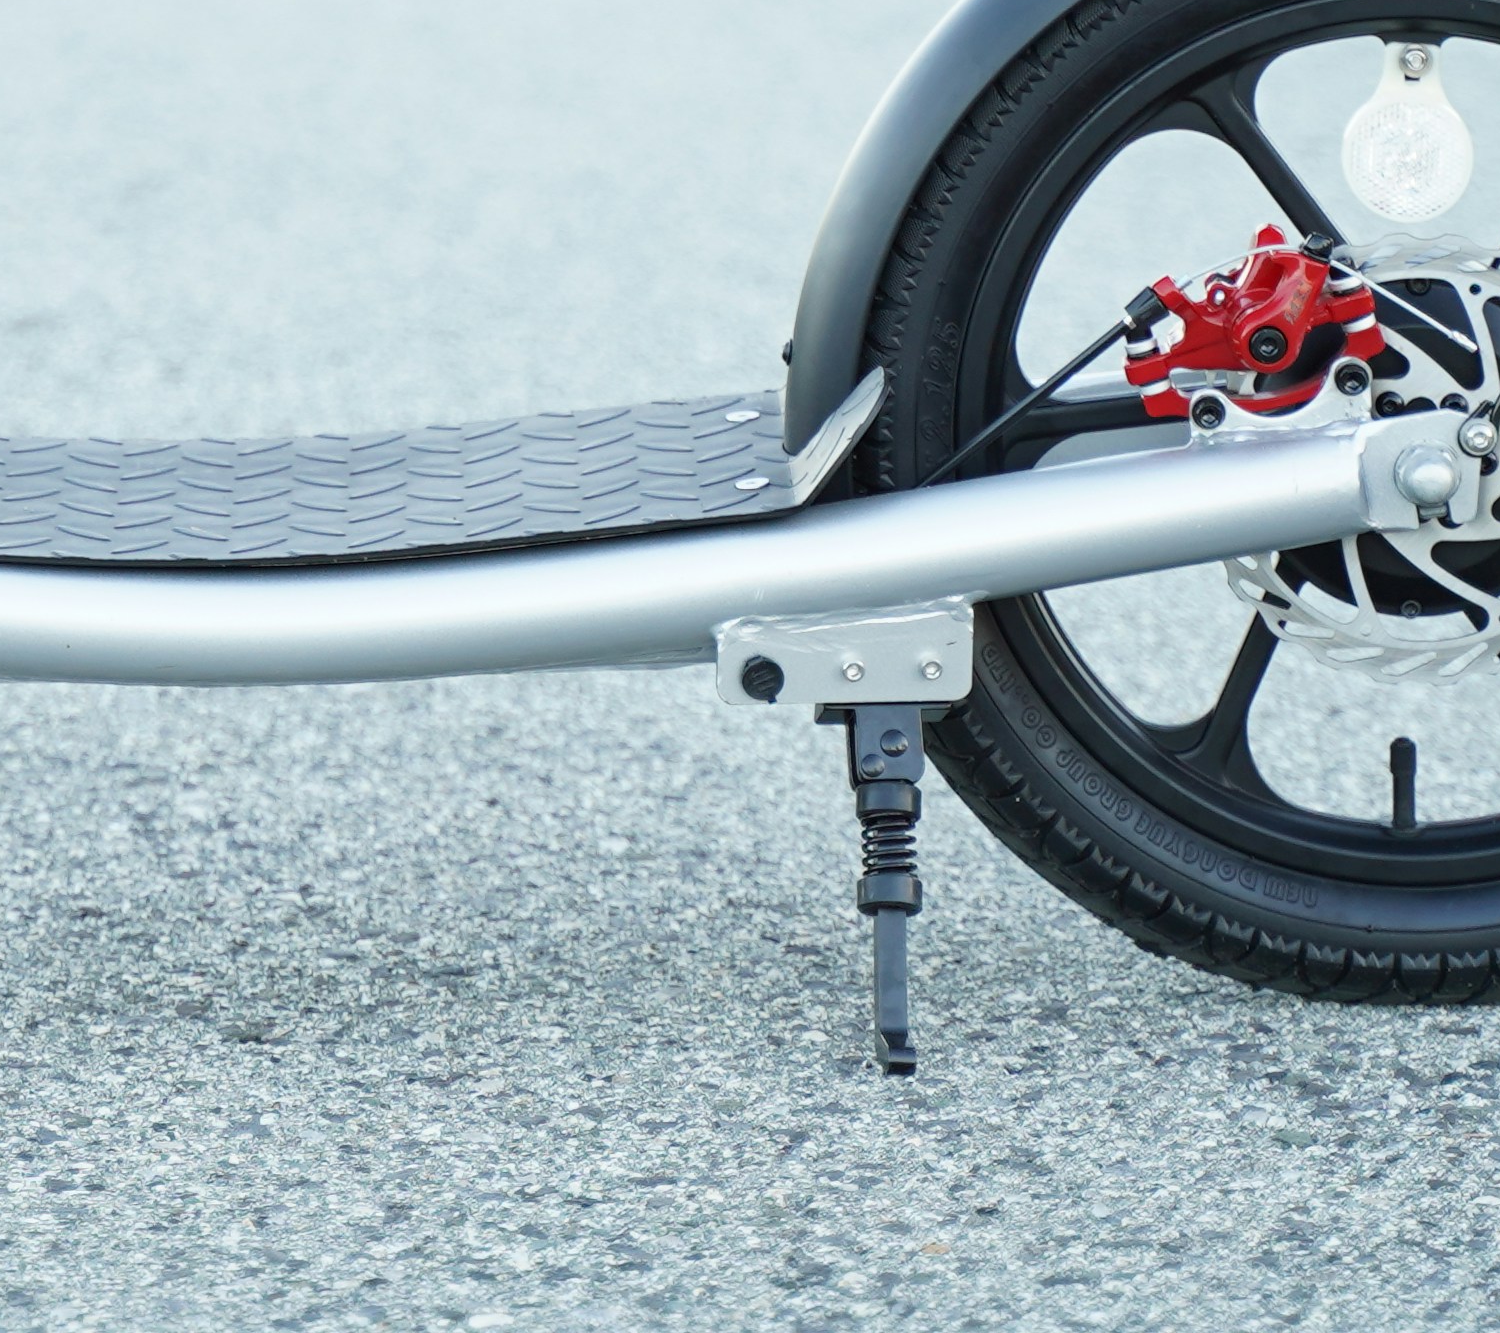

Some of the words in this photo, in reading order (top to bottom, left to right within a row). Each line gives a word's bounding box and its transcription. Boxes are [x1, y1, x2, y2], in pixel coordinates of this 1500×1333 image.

[1053, 747, 1136, 823] GROUP
[1132, 813, 1261, 892] DONGYUE
[1261, 873, 1320, 910] NEW
